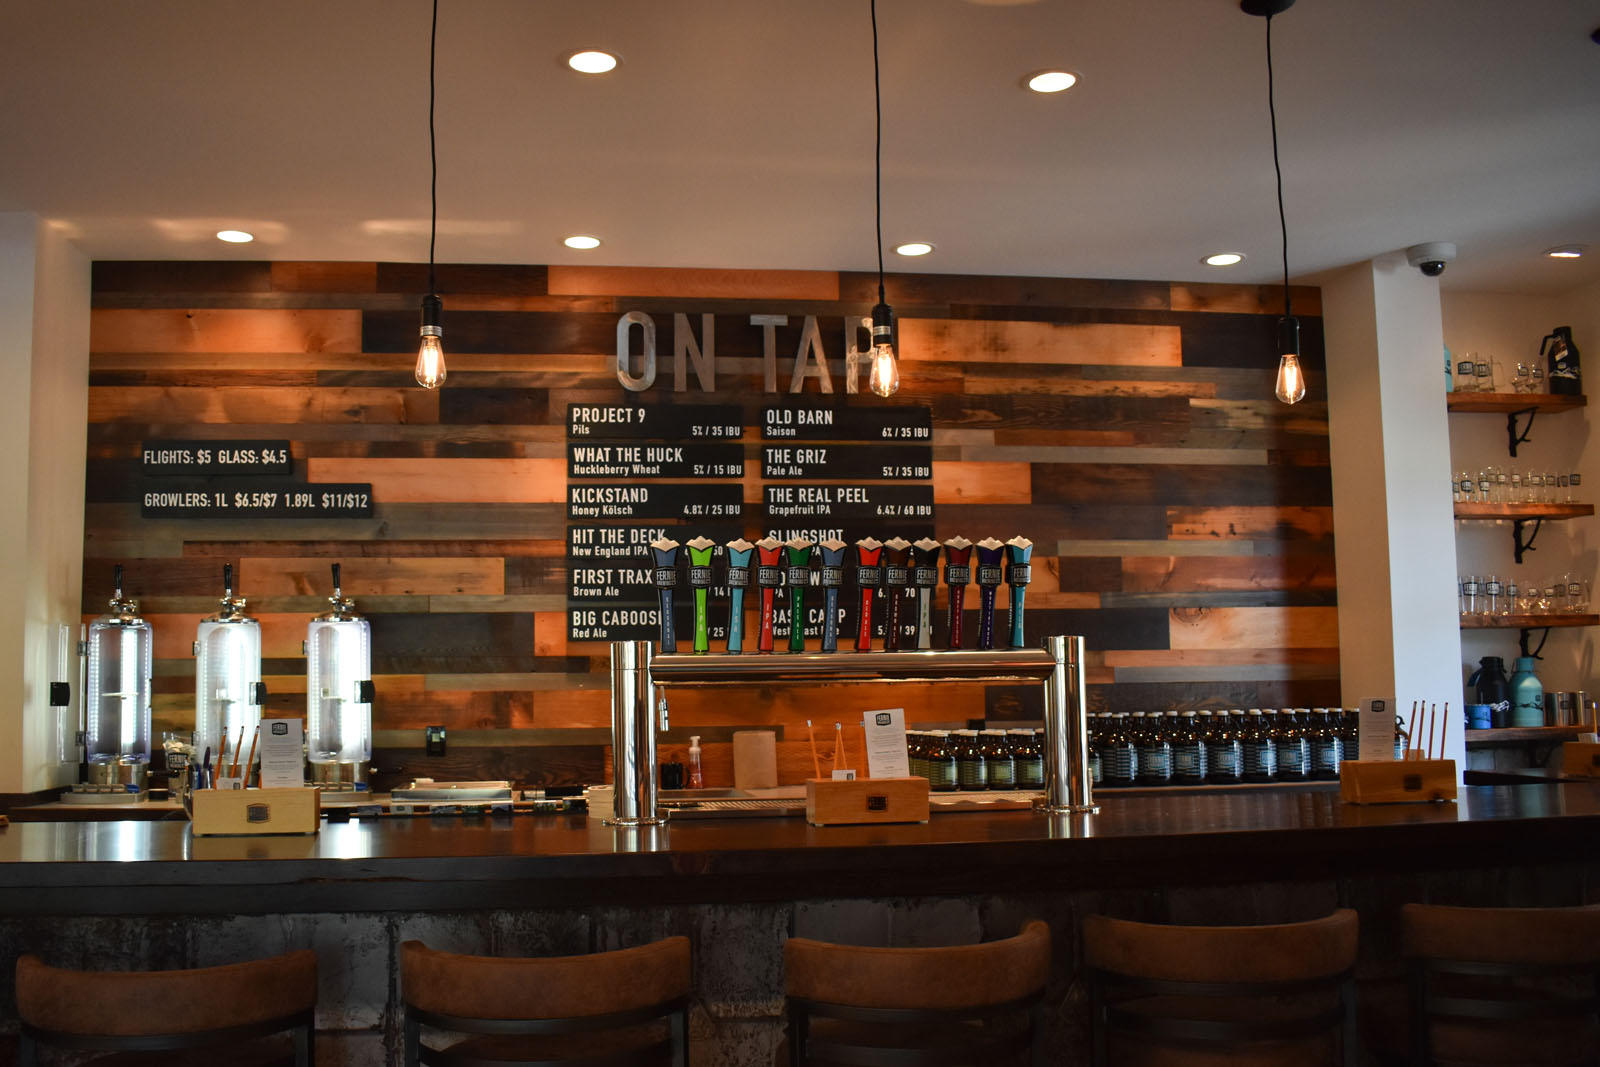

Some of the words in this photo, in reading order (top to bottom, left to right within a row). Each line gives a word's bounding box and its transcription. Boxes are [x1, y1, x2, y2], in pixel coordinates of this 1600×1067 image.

[617, 311, 715, 392] ON
[750, 314, 876, 394] TAP
[573, 408, 632, 422] PROJECT
[639, 409, 645, 422] 9
[767, 410, 791, 424] OLD
[798, 410, 832, 424] BARN
[573, 425, 589, 434] Pils
[693, 426, 702, 435] 5%
[712, 426, 722, 436] 35
[726, 426, 740, 436] IBU
[767, 426, 795, 435] Saison
[882, 428, 892, 437] 6%
[901, 428, 911, 437] 35
[914, 428, 928, 437] IBU
[144, 450, 193, 464] FLIGHTS:
[197, 449, 211, 464] $5
[219, 450, 258, 463] GLASS:
[262, 449, 286, 464] $4.5
[574, 448, 611, 462] WHAT
[616, 448, 641, 462] THE
[647, 448, 682, 462] HUCK
[767, 449, 790, 463] THE
[797, 449, 826, 463] GRIZ
[574, 464, 629, 476] Huckleberry
[632, 464, 659, 474] Wheat
[694, 465, 704, 474] 5%
[714, 465, 723, 474] 15
[727, 465, 741, 474] IBU
[767, 466, 785, 475] Pale
[789, 466, 802, 475] Ale
[883, 467, 893, 476] 5%
[902, 467, 911, 476] 35
[915, 467, 928, 476] IBU
[145, 493, 210, 507] GROWLERS:
[215, 493, 228, 506] 1L
[235, 492, 277, 508] $6.5/$7
[285, 494, 315, 507] 1.89L
[322, 493, 367, 508] $11/$12
[573, 488, 647, 503] KICKSTAND
[769, 488, 792, 502] THE
[799, 488, 831, 502] REAL
[838, 488, 869, 502] PEEL
[573, 505, 599, 517] Honey
[603, 505, 632, 514] Kölsch
[684, 505, 702, 514] 4.8%
[712, 505, 722, 514] 25
[726, 505, 740, 514] IBU
[769, 505, 814, 516] Grapefruit
[817, 505, 830, 514] IPA
[877, 505, 895, 514] 6.4%
[904, 506, 913, 515] 68
[917, 506, 931, 515] IBU
[573, 529, 594, 543] HIT
[600, 529, 624, 543] THE
[630, 529, 665, 543] DECK
[769, 529, 844, 545] SLINGSHOT
[573, 546, 591, 555] New
[595, 546, 630, 558] England
[634, 546, 648, 555] IPA
[574, 569, 613, 584] FIRST
[617, 568, 653, 585] TRAX
[574, 586, 601, 596] Brown
[605, 586, 619, 596] Ale
[714, 587, 724, 596] 14
[905, 588, 915, 597] 70
[573, 611, 596, 625] BIG
[809, 608, 846, 624] CAP
[573, 628, 589, 638] Red
[593, 628, 607, 637] Ale
[714, 627, 723, 637] 25
[905, 626, 915, 635] 39
